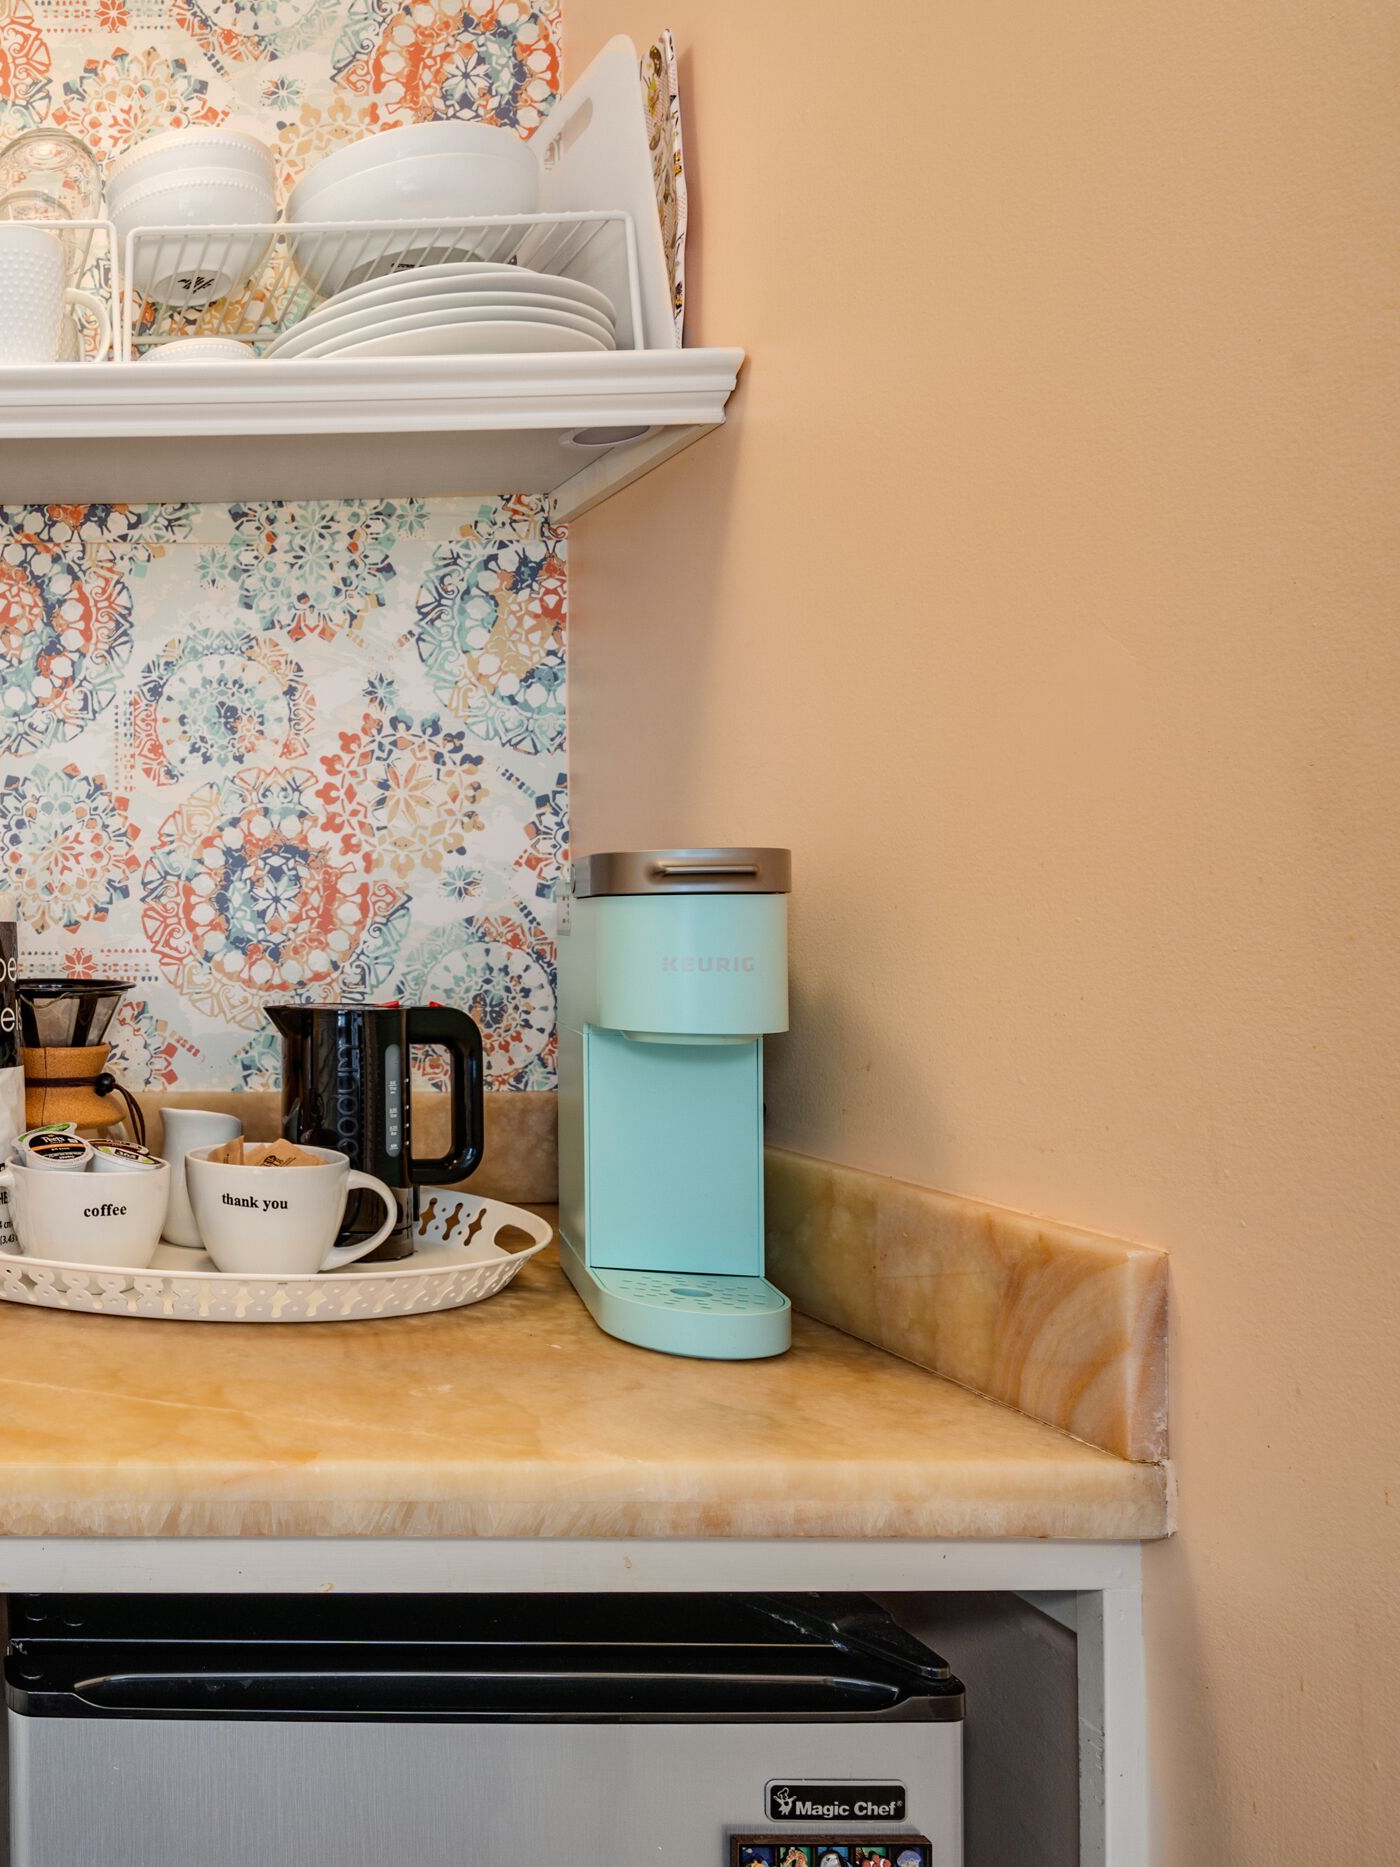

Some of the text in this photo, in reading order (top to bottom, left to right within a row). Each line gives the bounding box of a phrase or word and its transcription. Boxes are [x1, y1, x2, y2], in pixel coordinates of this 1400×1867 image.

[662, 956, 756, 973] KEURIG
[221, 1192, 289, 1212] thank you
[83, 1204, 128, 1218] coffee
[795, 1801, 897, 1819] Magic Chef
